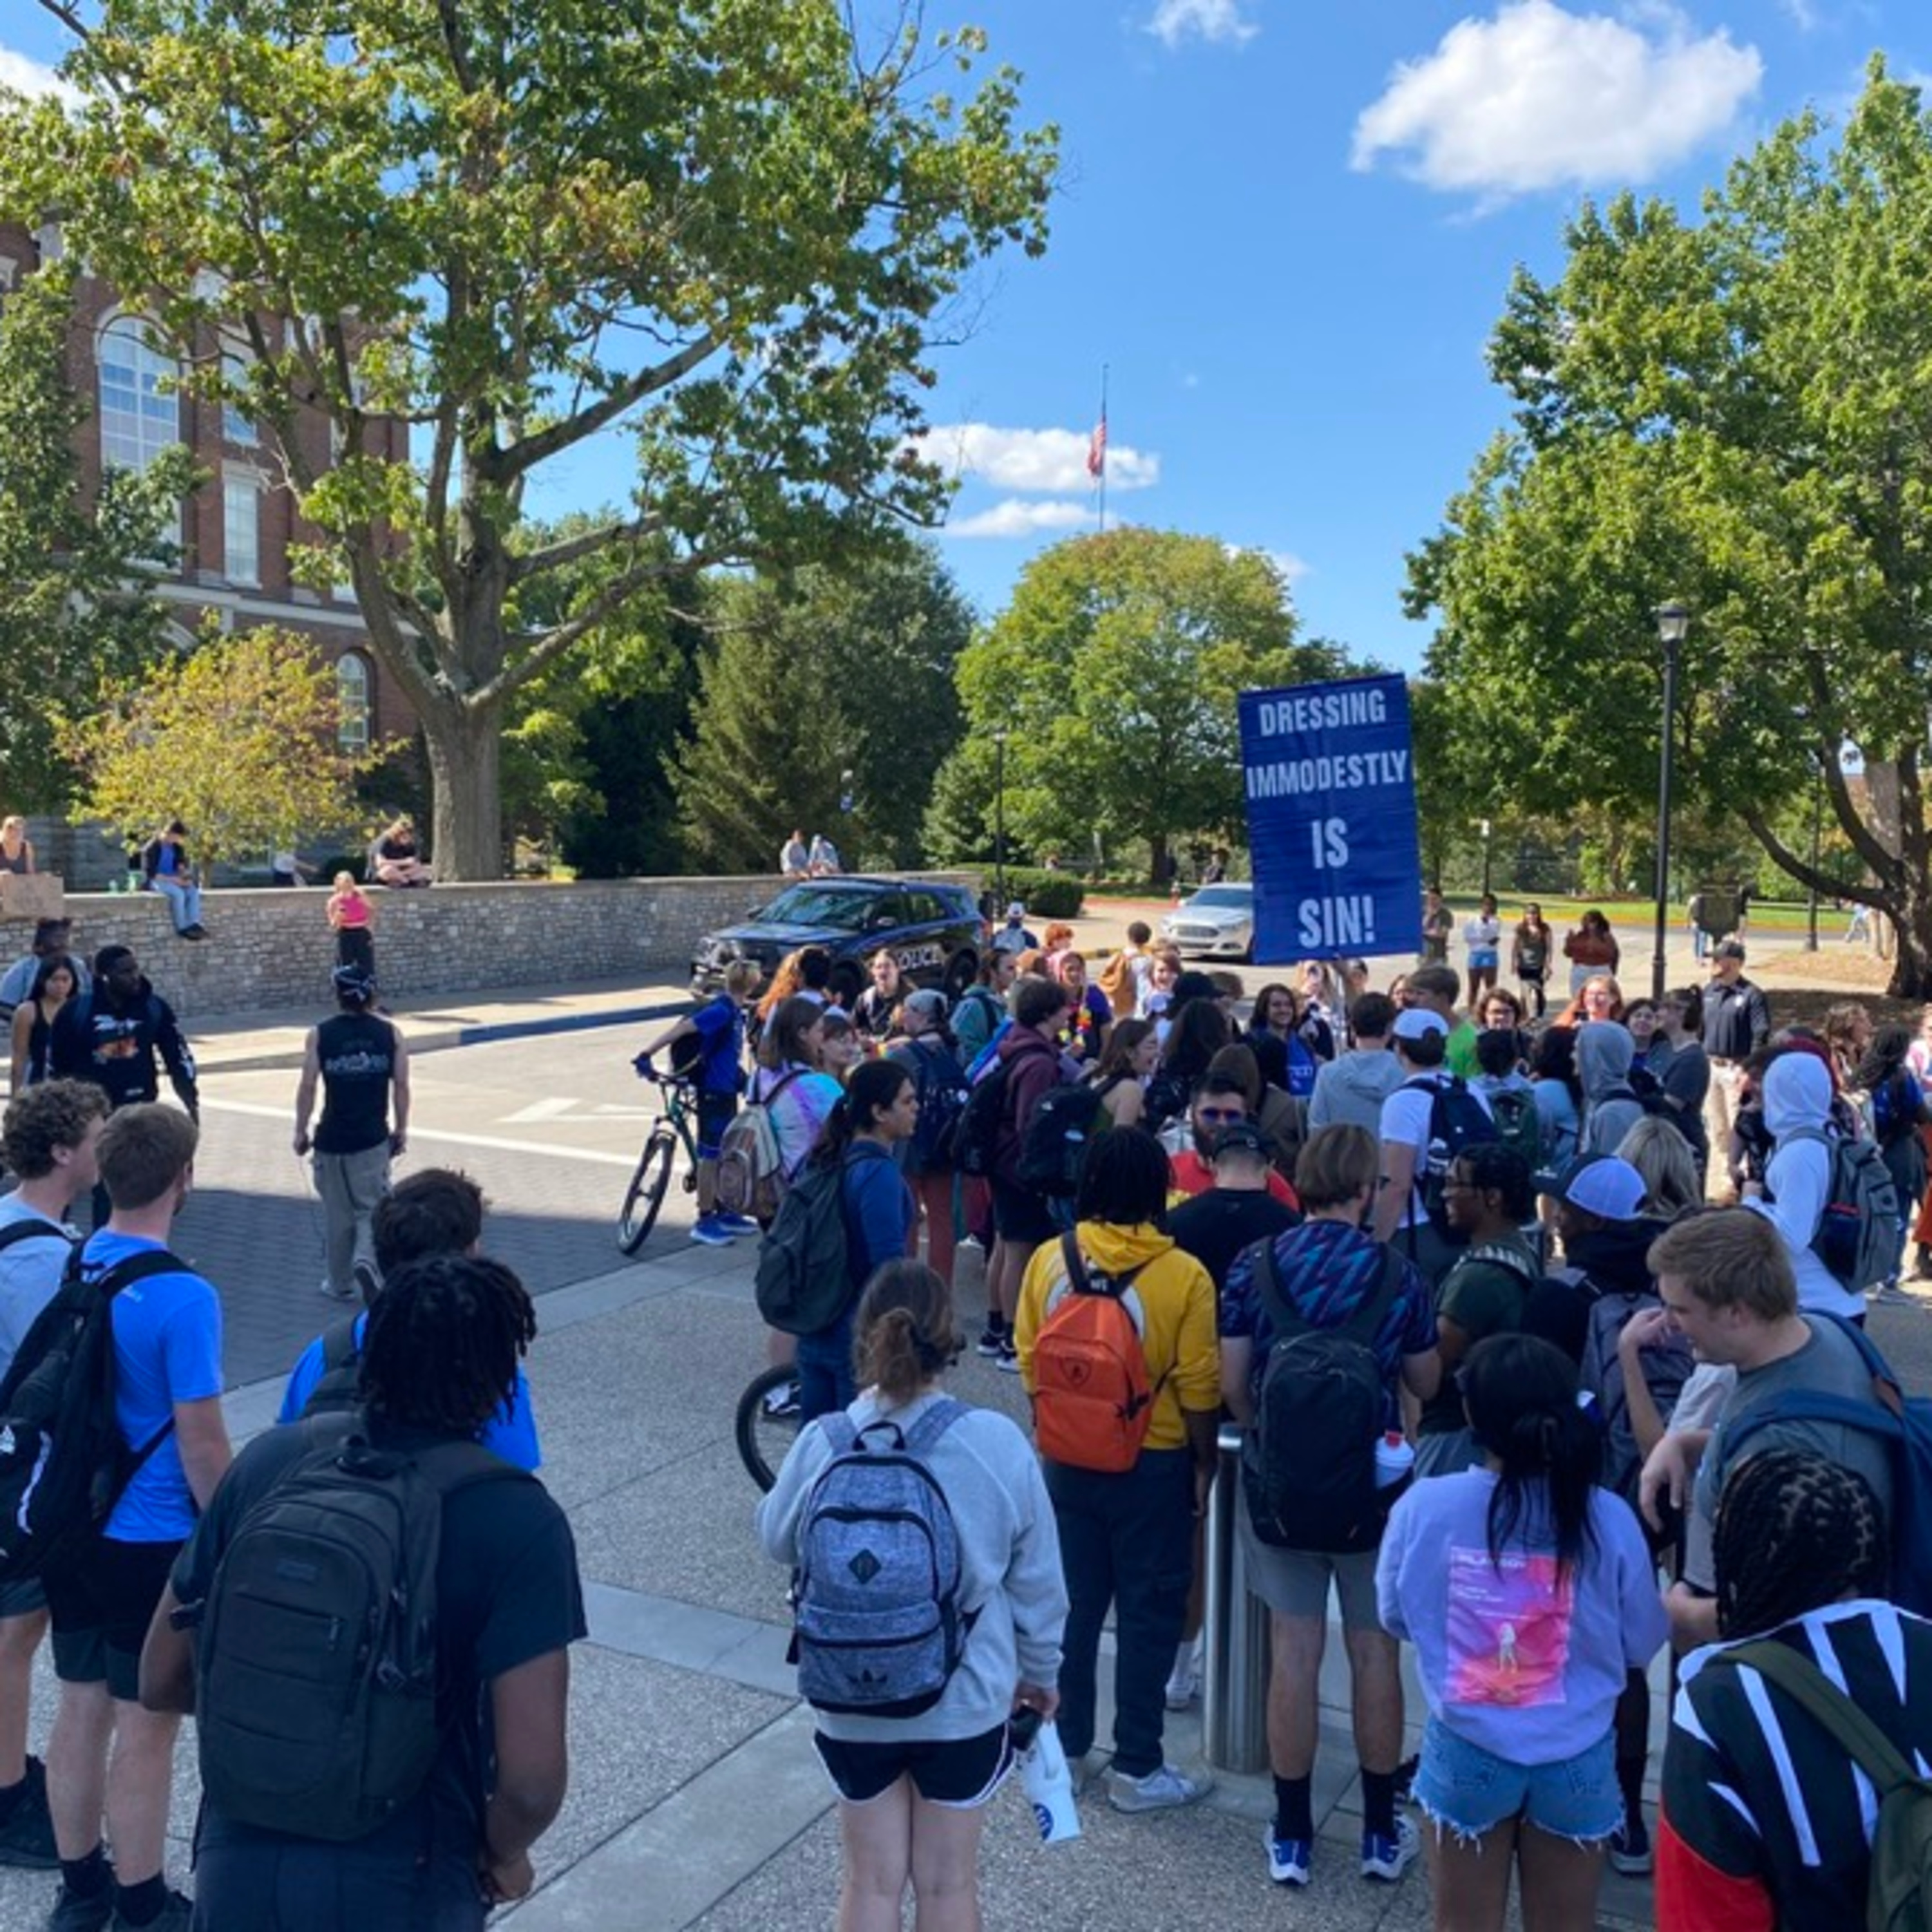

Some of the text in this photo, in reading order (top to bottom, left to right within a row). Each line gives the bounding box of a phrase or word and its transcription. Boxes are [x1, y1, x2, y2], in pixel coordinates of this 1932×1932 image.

[1258, 688, 1387, 737] DRESSING
[1245, 749, 1408, 799] IMMODESTLY
[1311, 817, 1349, 869] IS
[1297, 895, 1376, 949] SIN!
